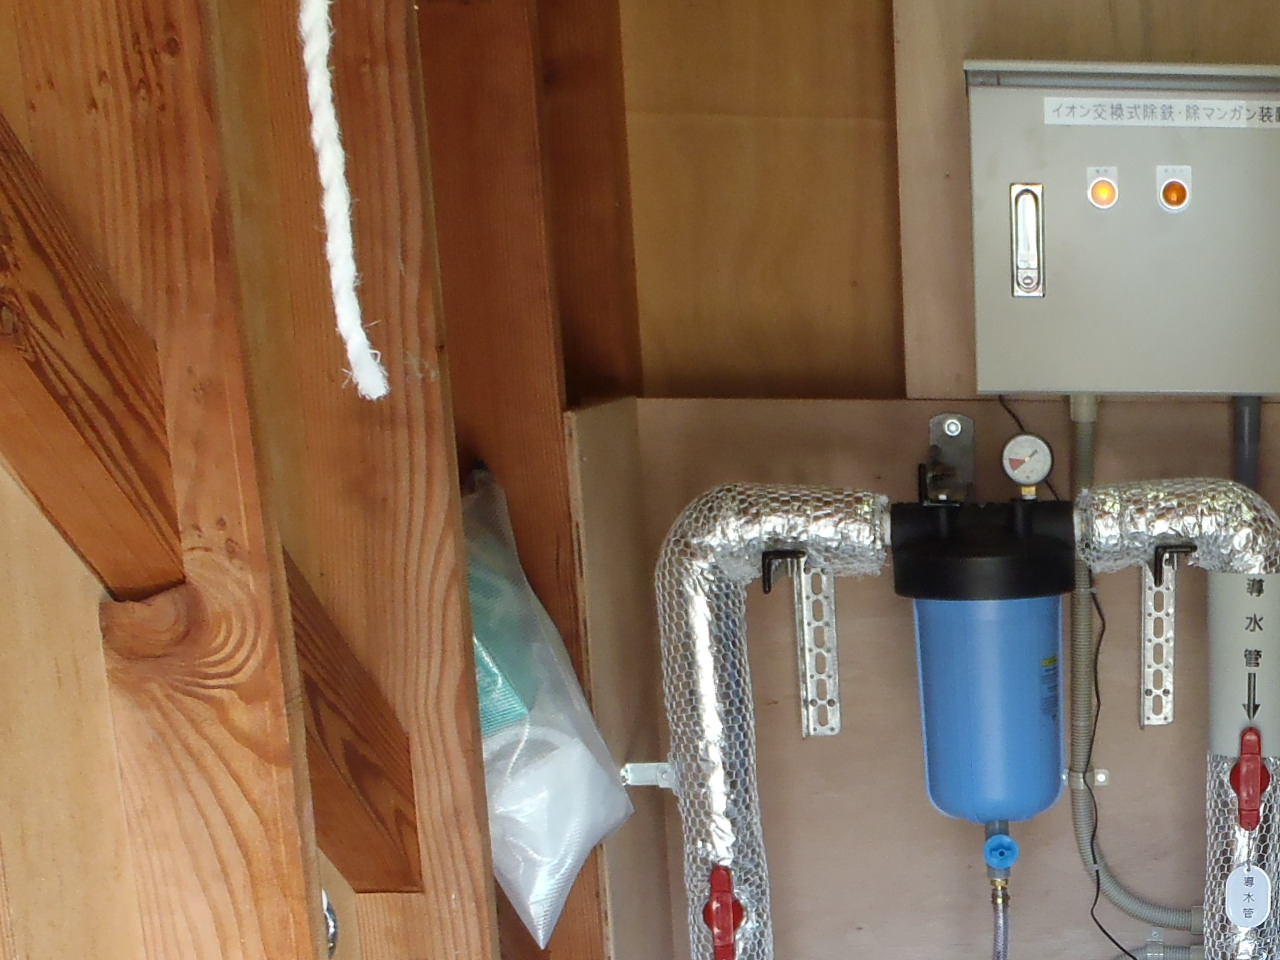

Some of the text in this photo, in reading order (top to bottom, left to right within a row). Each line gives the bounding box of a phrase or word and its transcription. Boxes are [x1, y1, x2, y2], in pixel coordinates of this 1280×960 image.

[1244, 578, 1265, 668] 導水管
[1243, 876, 1255, 919] 導水管
